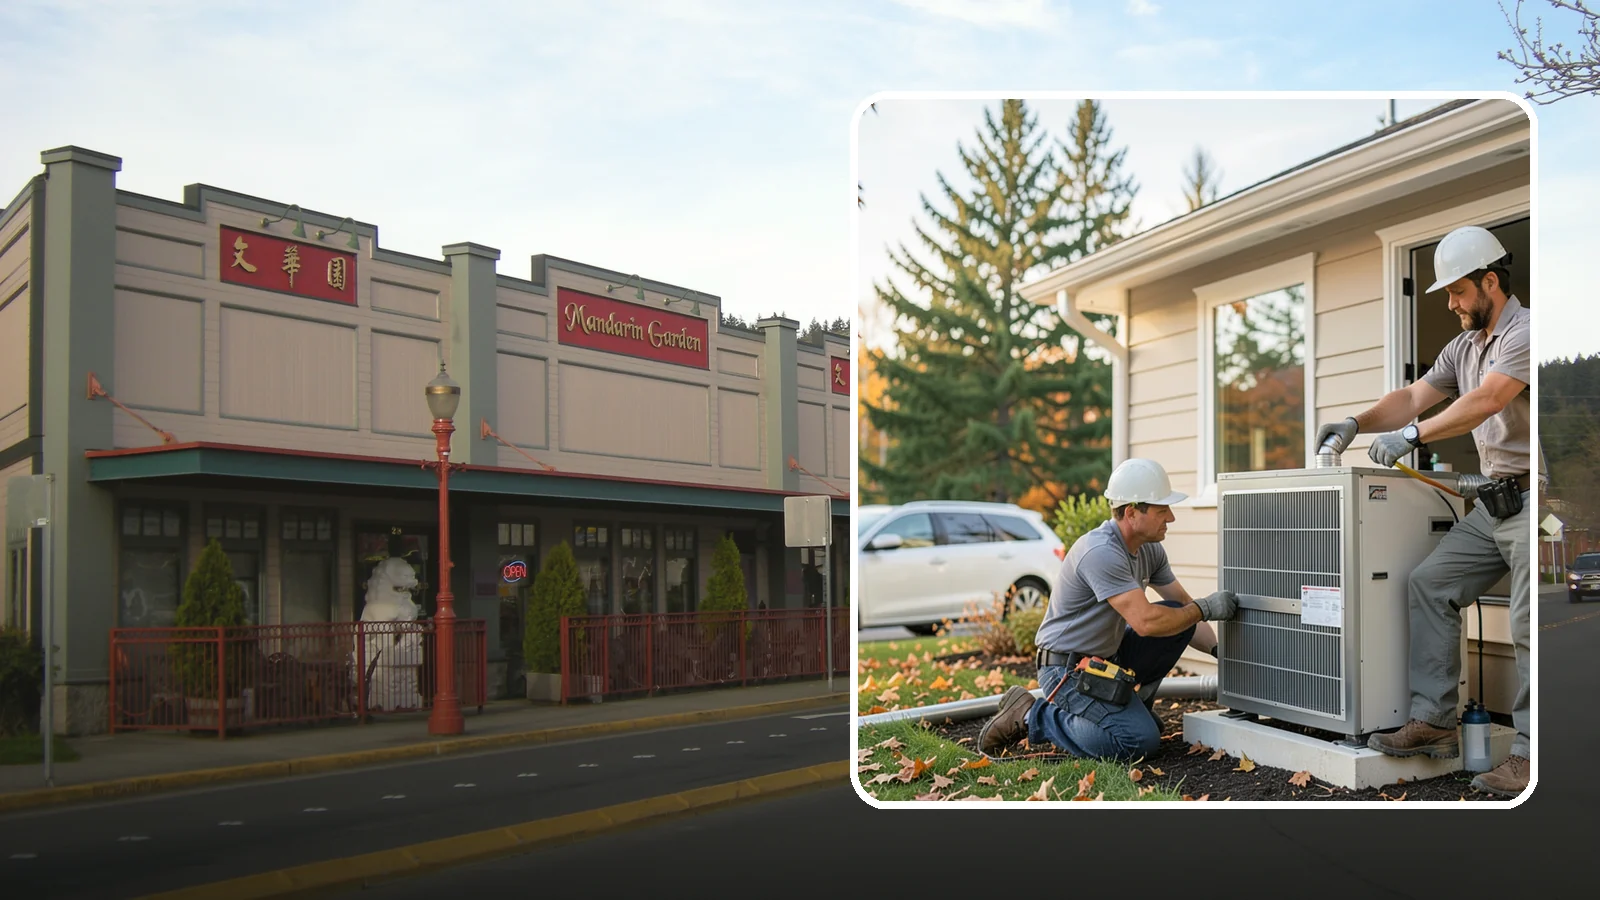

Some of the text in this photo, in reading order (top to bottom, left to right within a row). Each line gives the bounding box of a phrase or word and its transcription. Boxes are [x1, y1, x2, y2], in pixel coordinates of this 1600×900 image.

[564, 302, 701, 351] Mandarin Garden
[503, 565, 527, 578] OPEN
